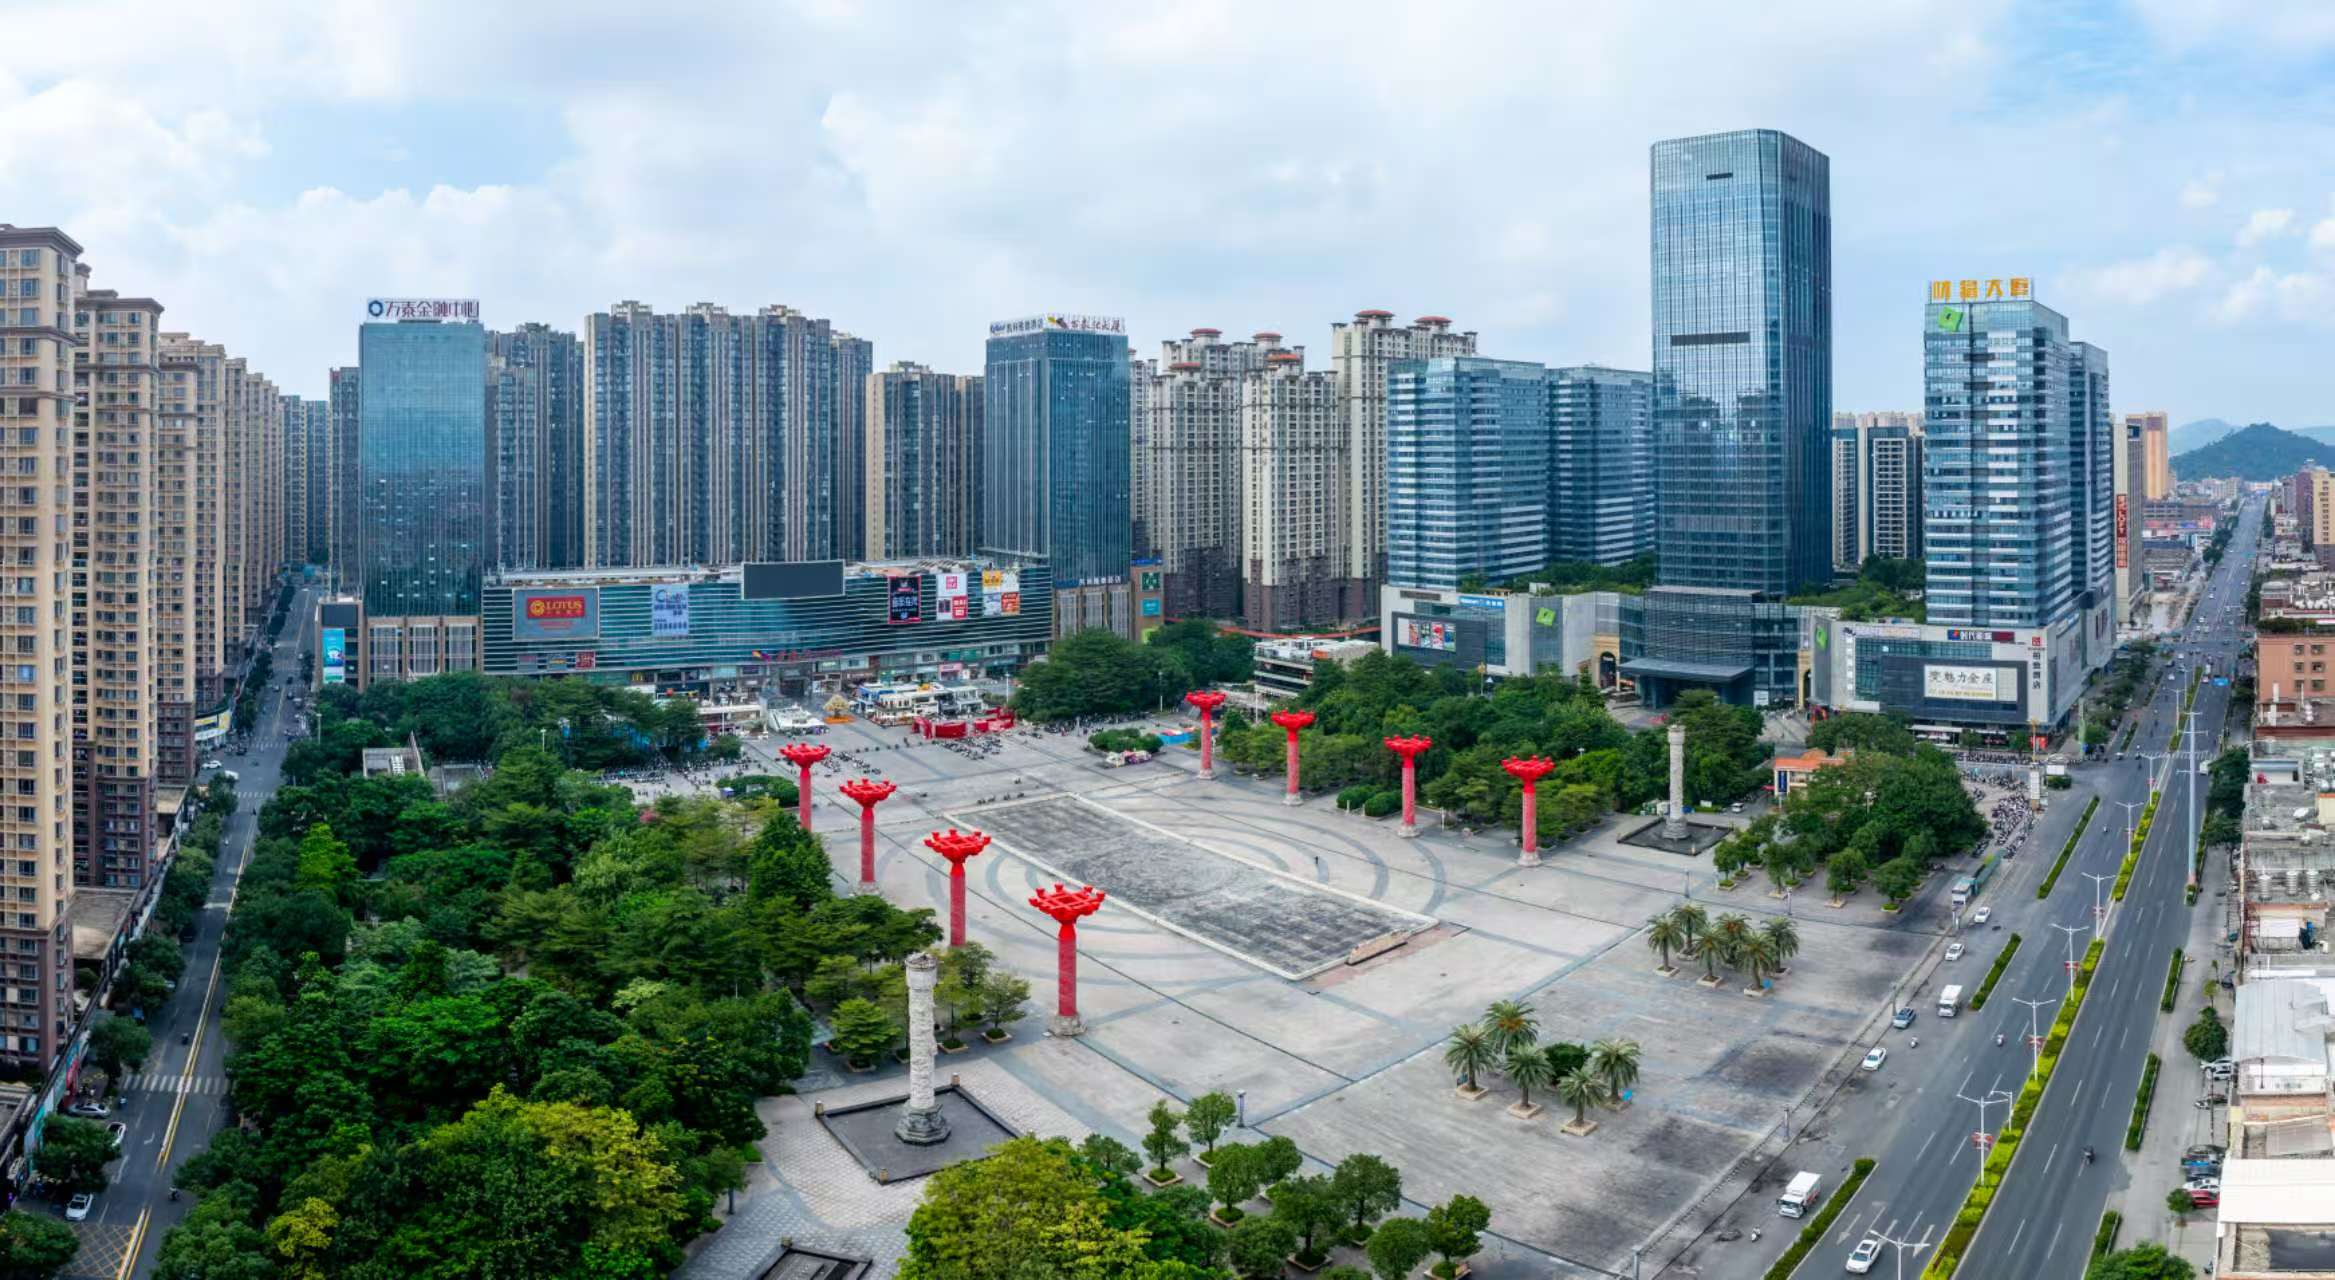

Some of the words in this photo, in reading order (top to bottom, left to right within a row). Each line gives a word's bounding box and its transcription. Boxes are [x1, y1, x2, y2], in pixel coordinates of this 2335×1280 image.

[384, 300, 480, 318] 万泰金融中心
[546, 600, 583, 609] LOTUS
